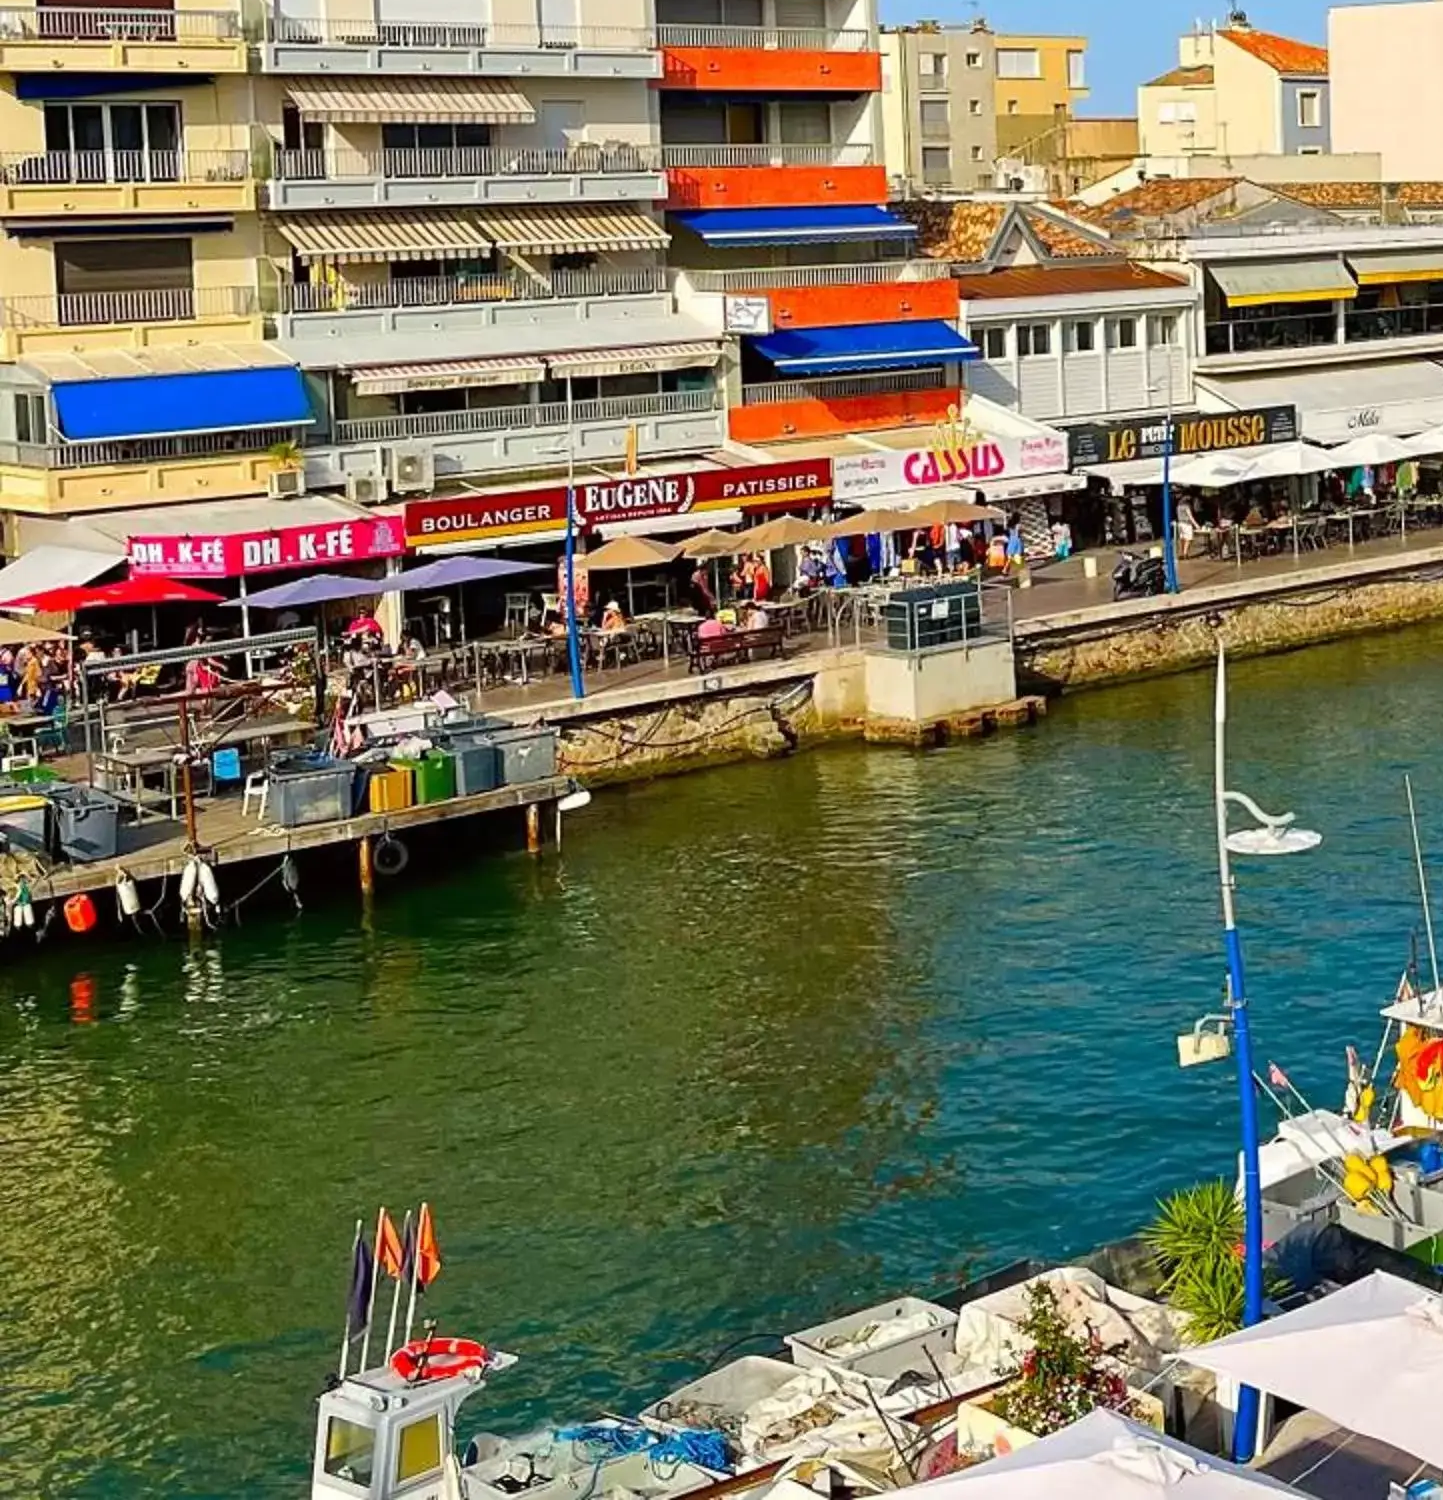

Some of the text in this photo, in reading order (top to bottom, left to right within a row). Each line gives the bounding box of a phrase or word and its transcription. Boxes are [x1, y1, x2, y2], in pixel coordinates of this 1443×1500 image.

[903, 442, 1005, 486] CASSUS
[723, 473, 819, 498] PATISSIER
[421, 504, 552, 533] BOULANGER
[131, 543, 162, 564] DH
[243, 537, 281, 567] DH
